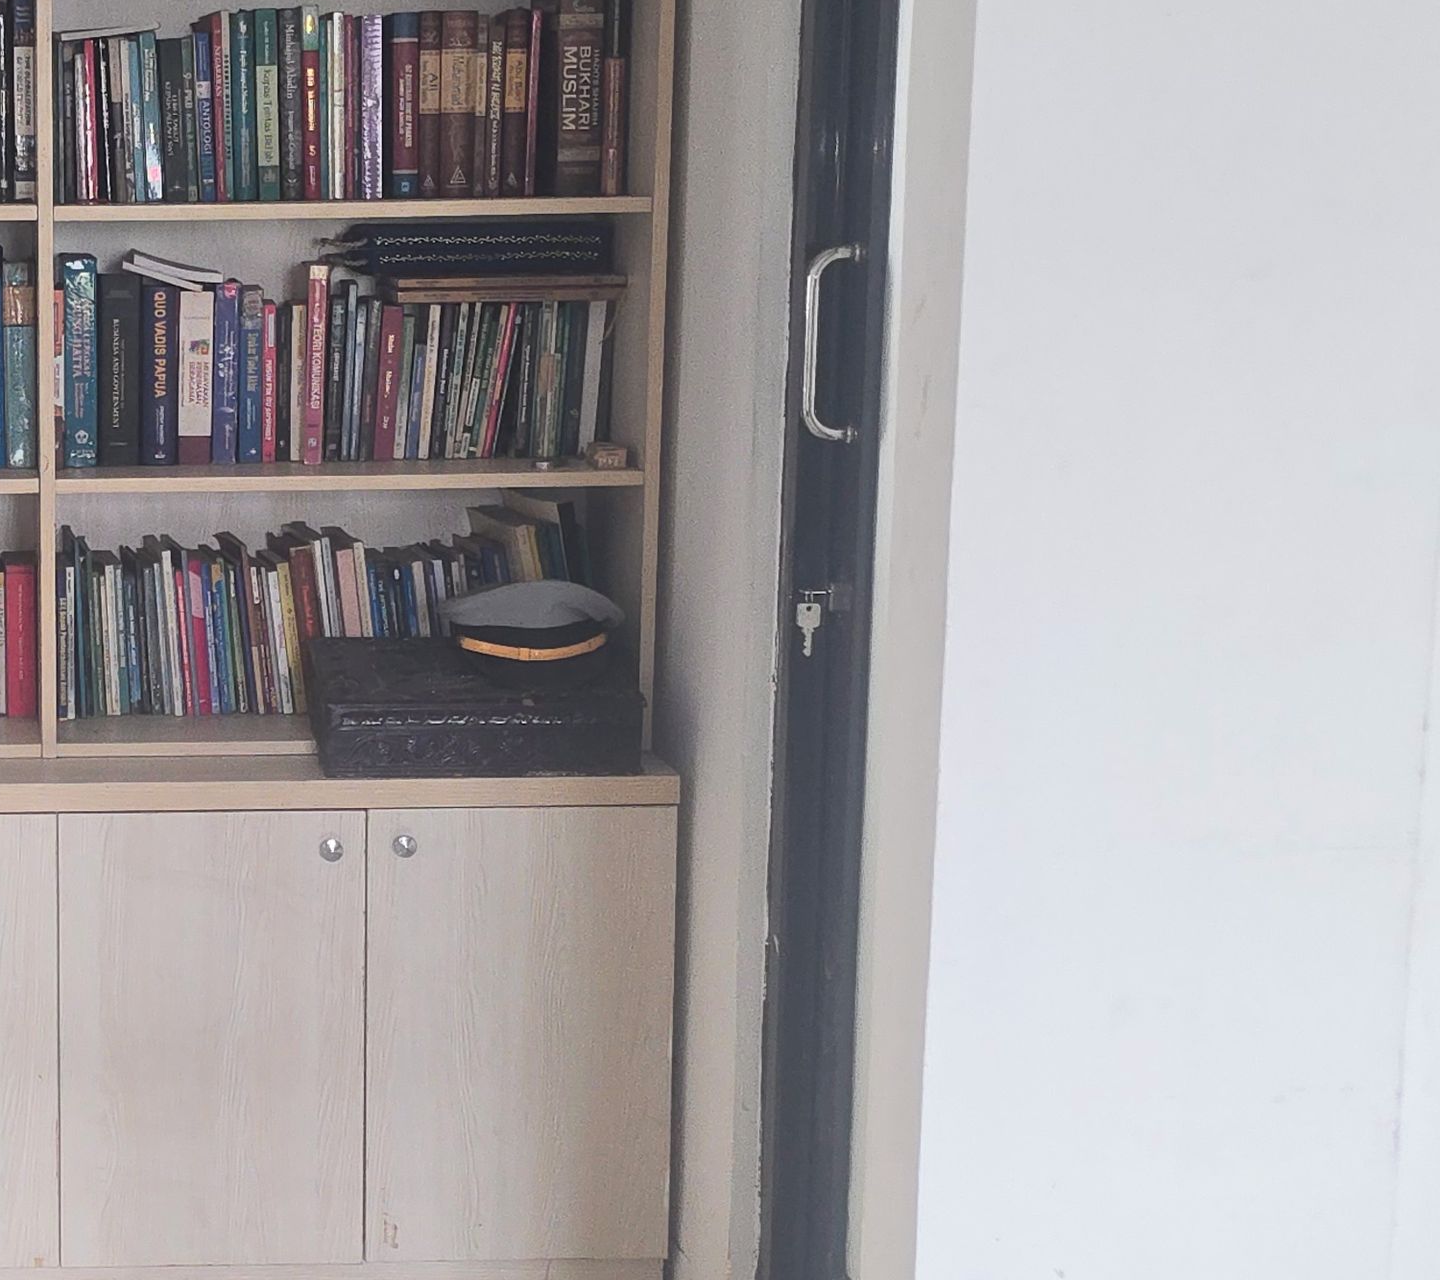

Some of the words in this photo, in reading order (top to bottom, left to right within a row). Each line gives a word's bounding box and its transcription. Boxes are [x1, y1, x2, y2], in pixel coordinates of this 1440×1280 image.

[285, 67, 296, 99] Abidin
[429, 73, 438, 91] Ali
[450, 54, 465, 106] Muhammad
[562, 46, 577, 131] MUSLIM
[578, 46, 591, 131] BUKHARI
[154, 291, 166, 318] QUO
[154, 320, 167, 356] VADIS
[312, 323, 323, 351] TEORI
[72, 337, 83, 378] HATTA
[155, 359, 167, 398] PAPUA
[310, 352, 322, 409] KOMUNIKASI
[112, 376, 120, 428] GOVERNMENT
